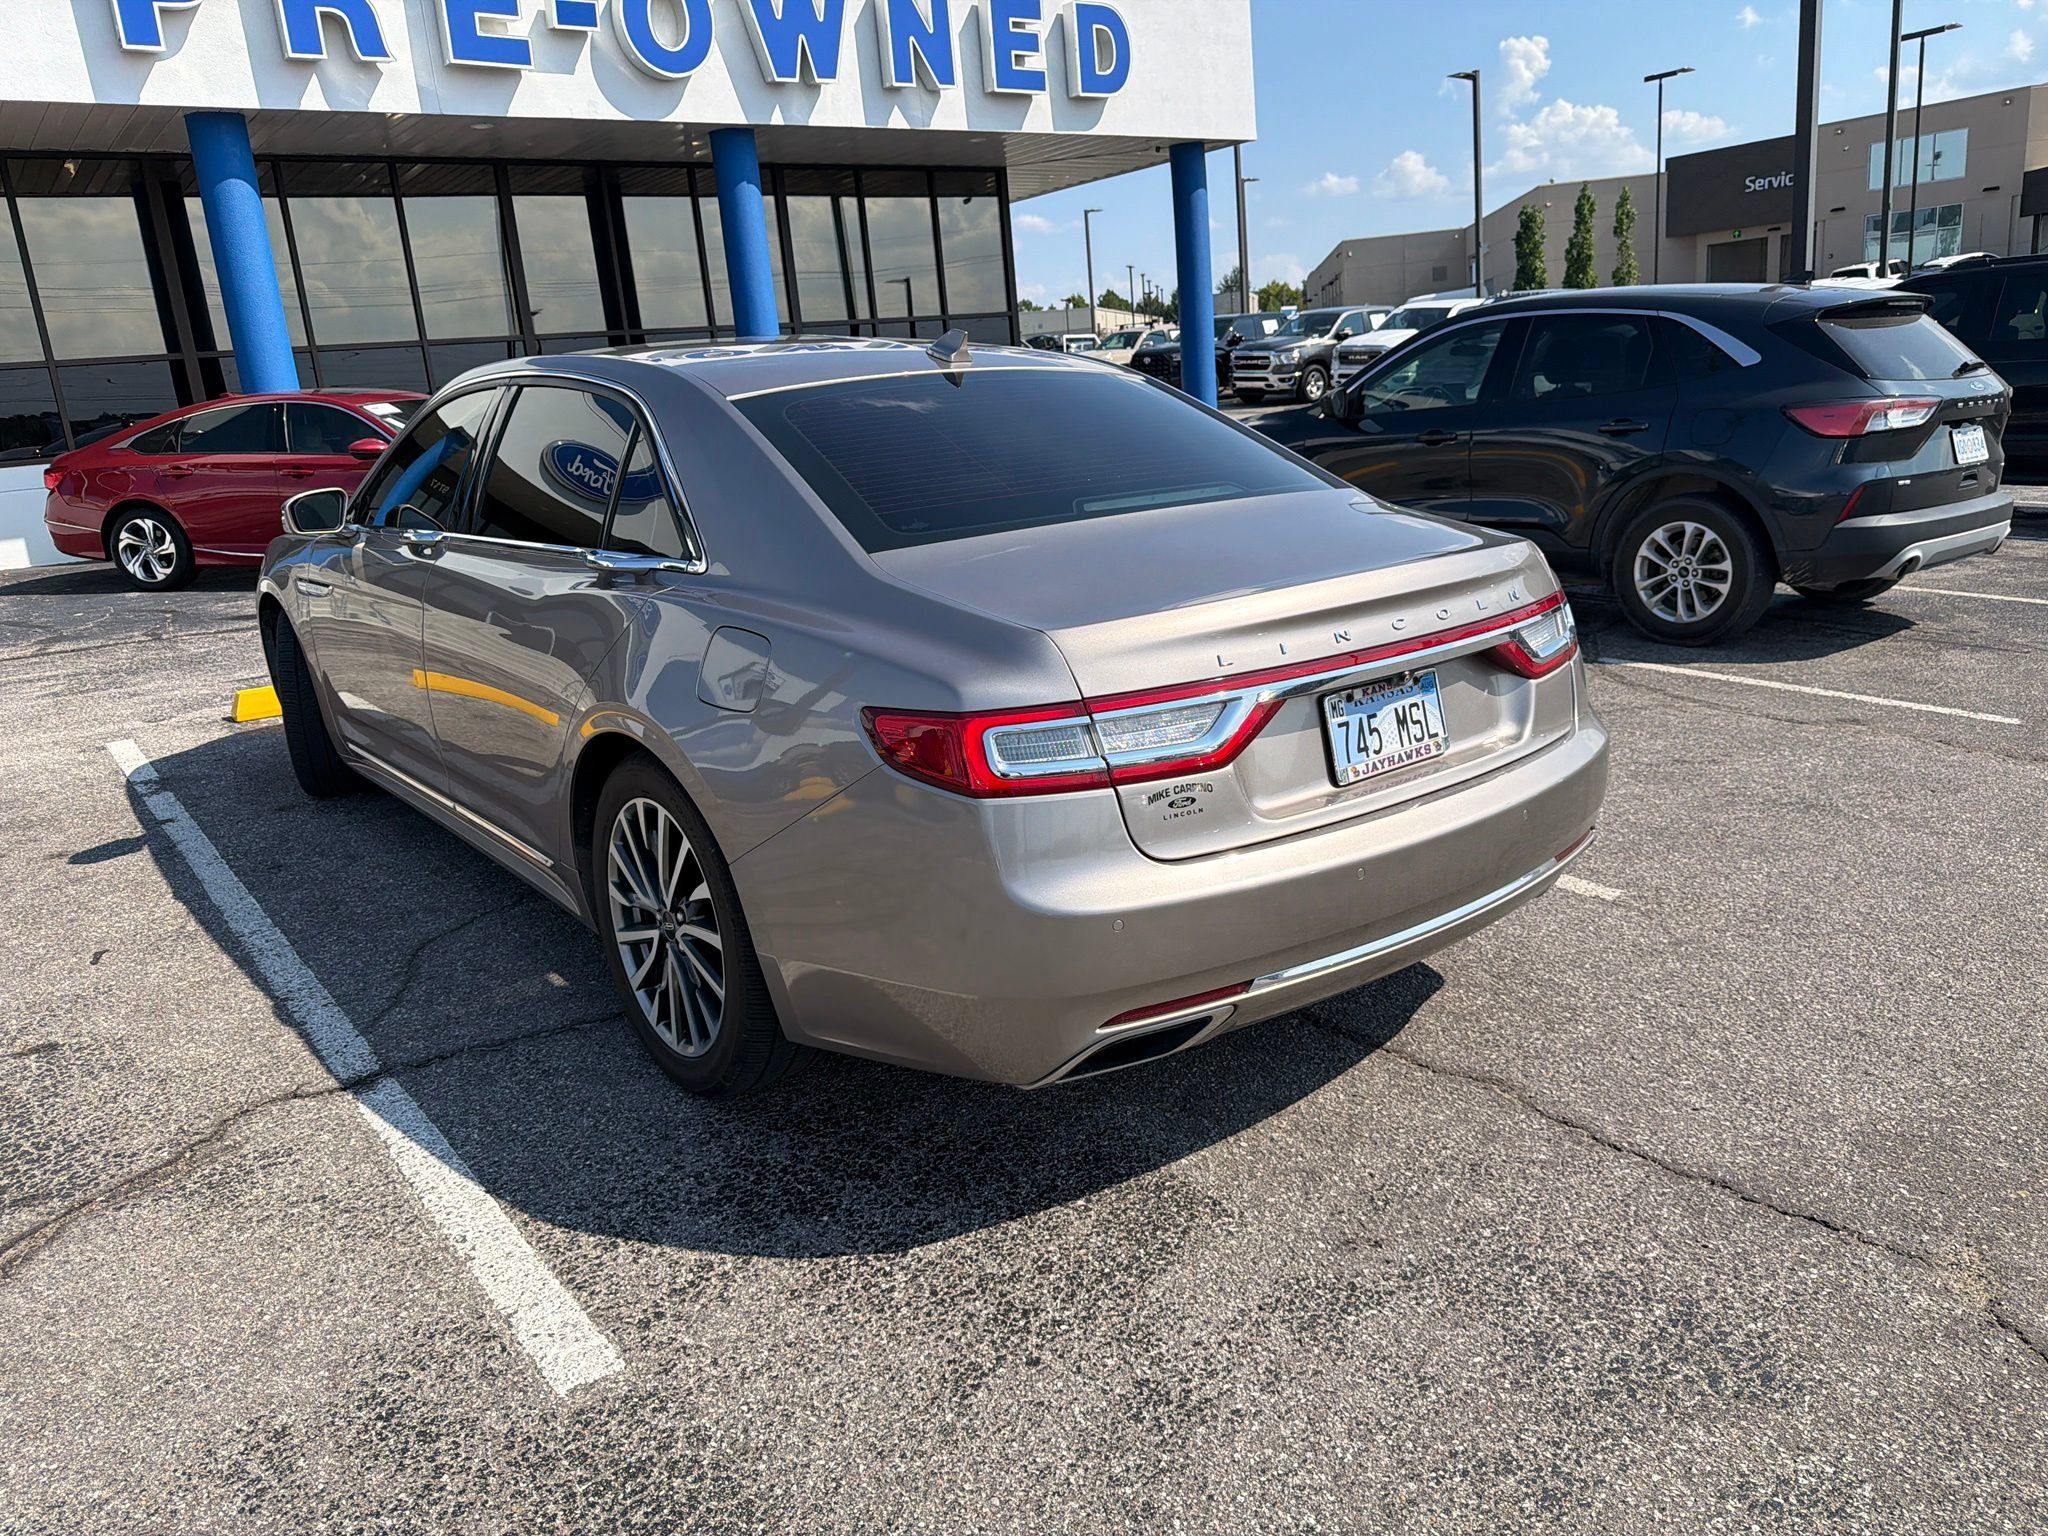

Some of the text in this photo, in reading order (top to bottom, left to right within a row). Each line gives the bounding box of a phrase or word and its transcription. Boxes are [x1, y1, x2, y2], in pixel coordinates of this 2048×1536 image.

[1744, 171, 1795, 193] Servic
[1217, 589, 1521, 668] LINCOLN
[1330, 700, 1345, 719] MG
[1338, 700, 1439, 764] 745 MSL
[1362, 744, 1432, 775] JAYHAWKS
[1147, 788, 1171, 805] MIKE
[1163, 808, 1204, 820] LINCOLN
